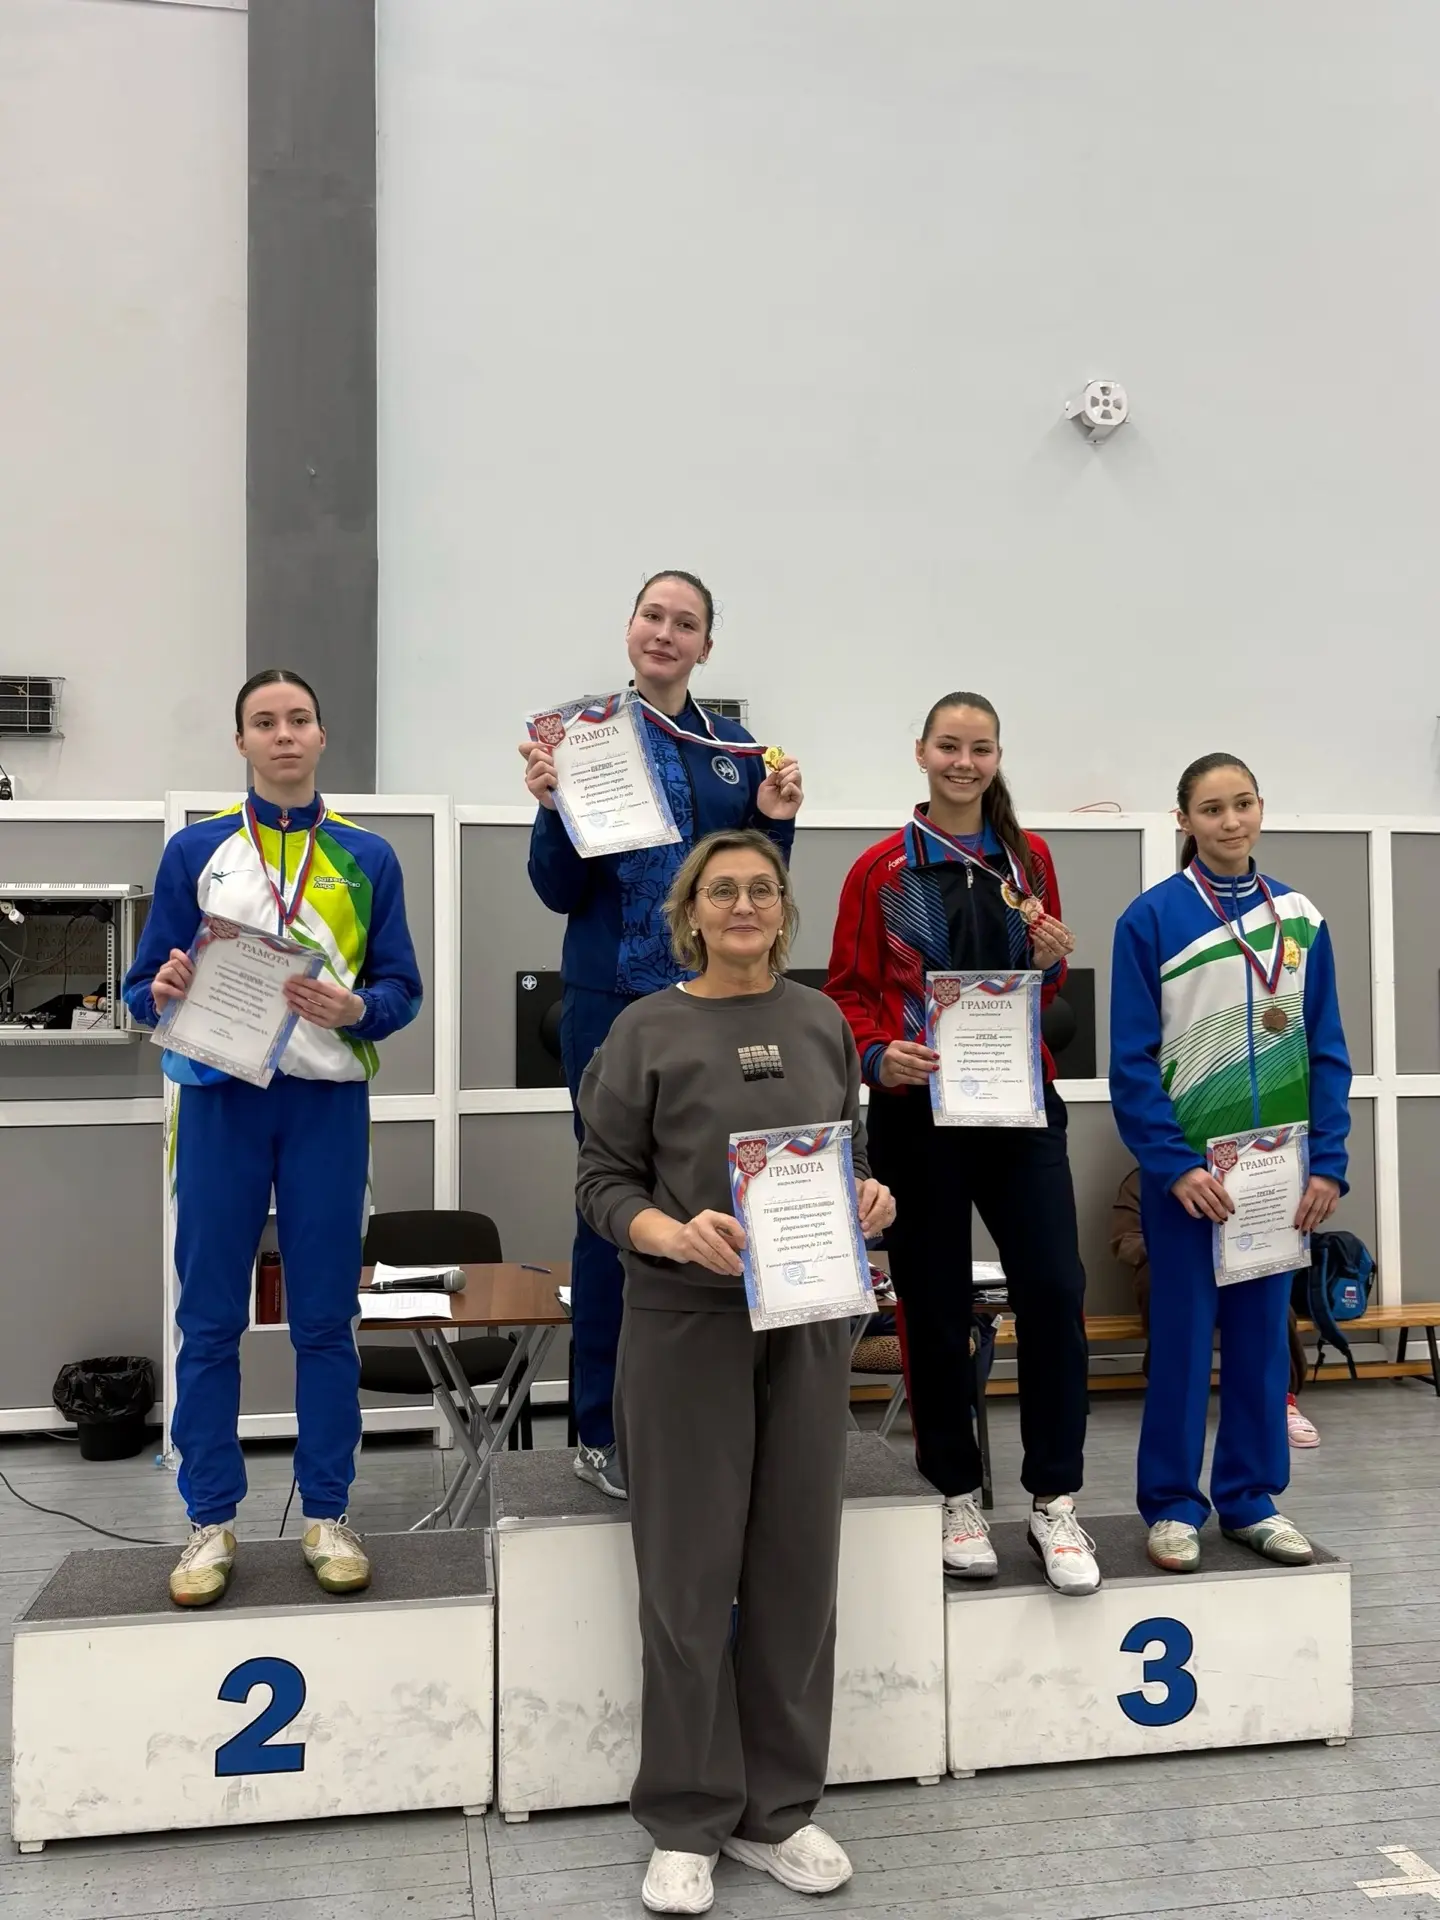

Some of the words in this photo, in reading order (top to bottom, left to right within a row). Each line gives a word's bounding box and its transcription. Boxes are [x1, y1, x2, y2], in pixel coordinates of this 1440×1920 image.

[568, 726, 619, 746] ГРАМОТА
[236, 940, 290, 967] ГРАМОТА
[961, 1000, 1012, 1010] ГРАМОТА
[769, 1162, 824, 1178] ГРАМОТА
[1240, 1155, 1286, 1171] ГРАМОТА
[1116, 1616, 1198, 1727] 3
[214, 1656, 307, 1778] 2
